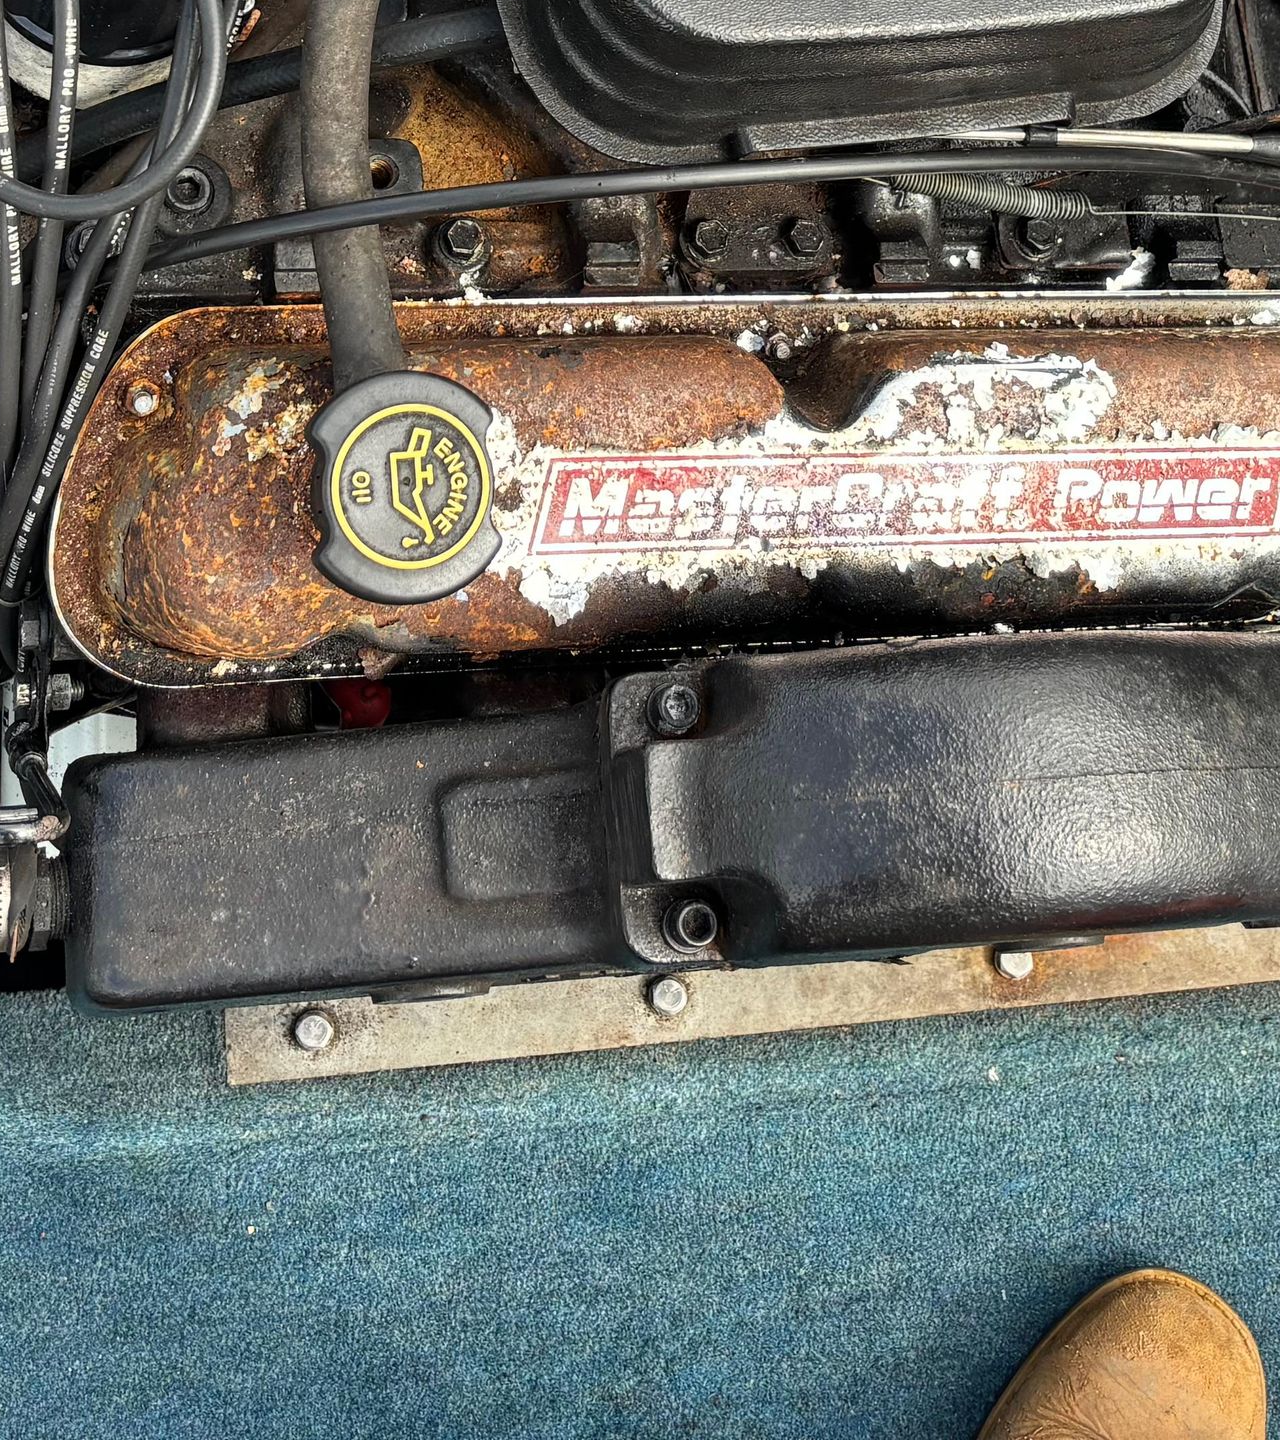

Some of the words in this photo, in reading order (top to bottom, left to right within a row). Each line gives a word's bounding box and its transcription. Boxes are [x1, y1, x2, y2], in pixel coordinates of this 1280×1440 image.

[55, 105, 71, 169] MALLORY
[8, 226, 21, 285] MALLORY
[42, 432, 65, 477] SILICONE
[61, 363, 95, 429] SUPPRESSION
[90, 330, 109, 359] CORE
[351, 470, 373, 504] OIL
[433, 437, 469, 536] ENGINE
[561, 466, 1024, 539] MasterCraft
[1056, 470, 1271, 526] Power
